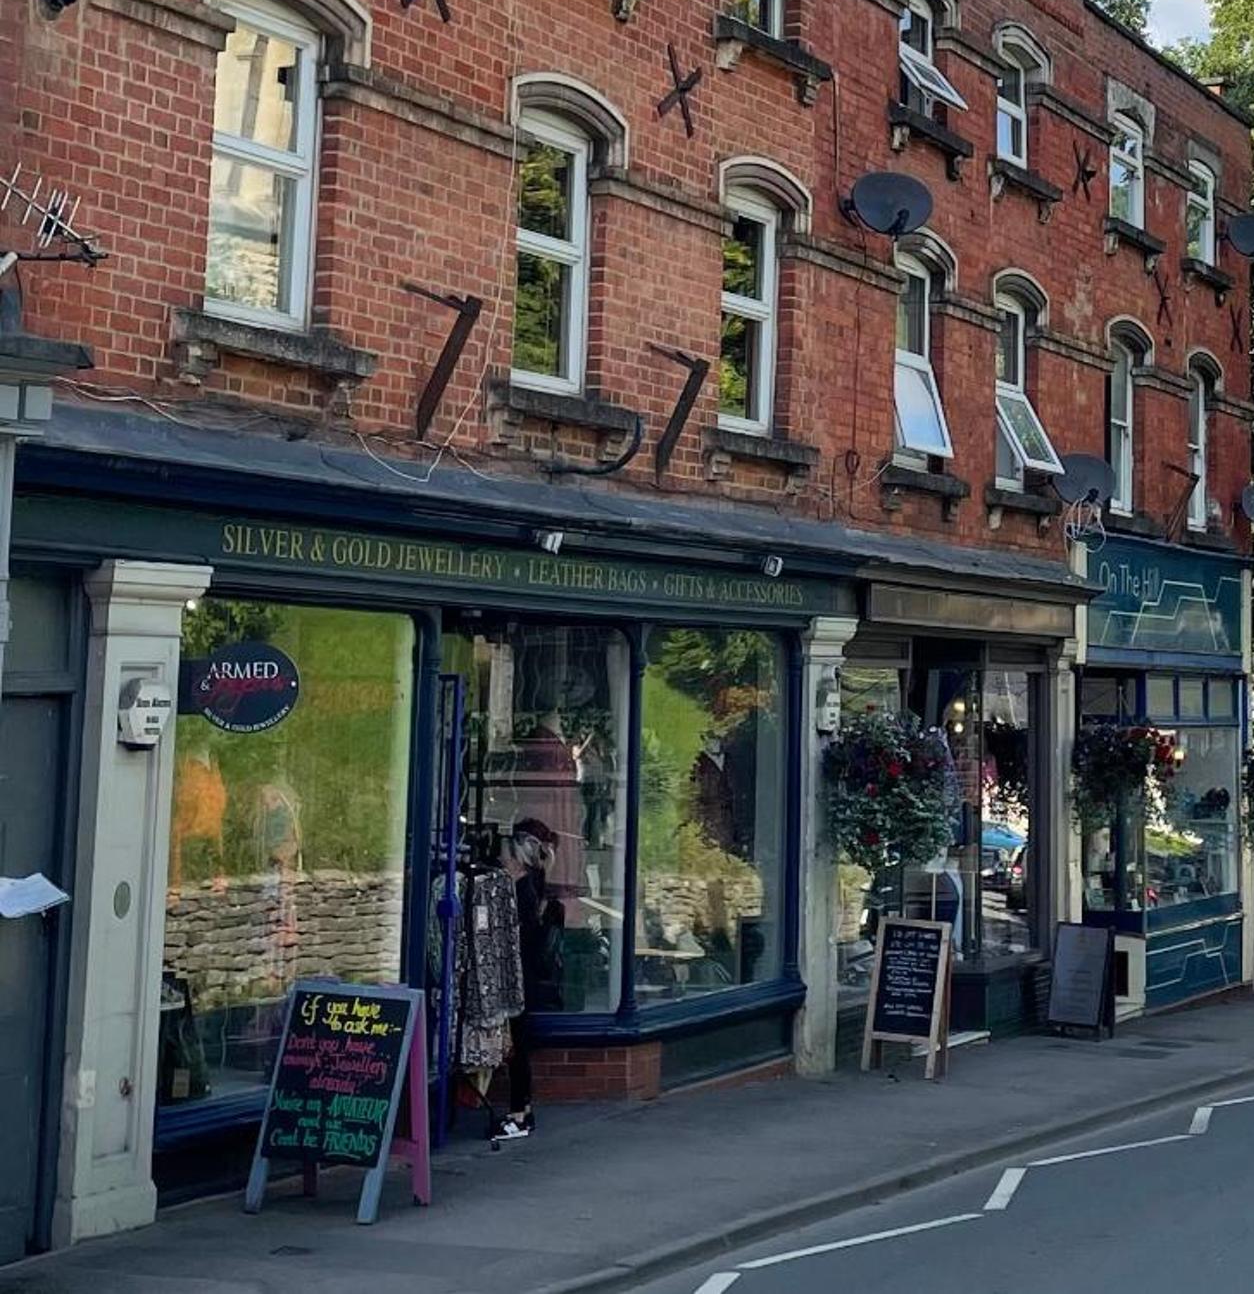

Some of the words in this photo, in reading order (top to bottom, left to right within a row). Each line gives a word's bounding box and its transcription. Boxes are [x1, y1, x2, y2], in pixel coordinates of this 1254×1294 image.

[222, 524, 303, 560] SILVER
[310, 534, 325, 562] &
[333, 536, 391, 569] GOLD
[396, 544, 505, 581] JEWELLERY
[528, 560, 608, 590] LEATHER
[608, 568, 647, 595] BAGS
[664, 573, 702, 598] GIFTS
[705, 582, 716, 600] &
[719, 580, 803, 606] ACCESSORIES
[1100, 561, 1117, 595] On
[1119, 564, 1140, 598] The
[207, 661, 279, 680] ARMED
[200, 679, 210, 691] &
[301, 994, 324, 1026] if
[322, 1001, 348, 1025] you
[351, 997, 381, 1020] have
[330, 1016, 342, 1032] to
[344, 1017, 370, 1035] ask
[319, 1039, 340, 1057] you
[322, 1130, 379, 1157] FRIENDS
